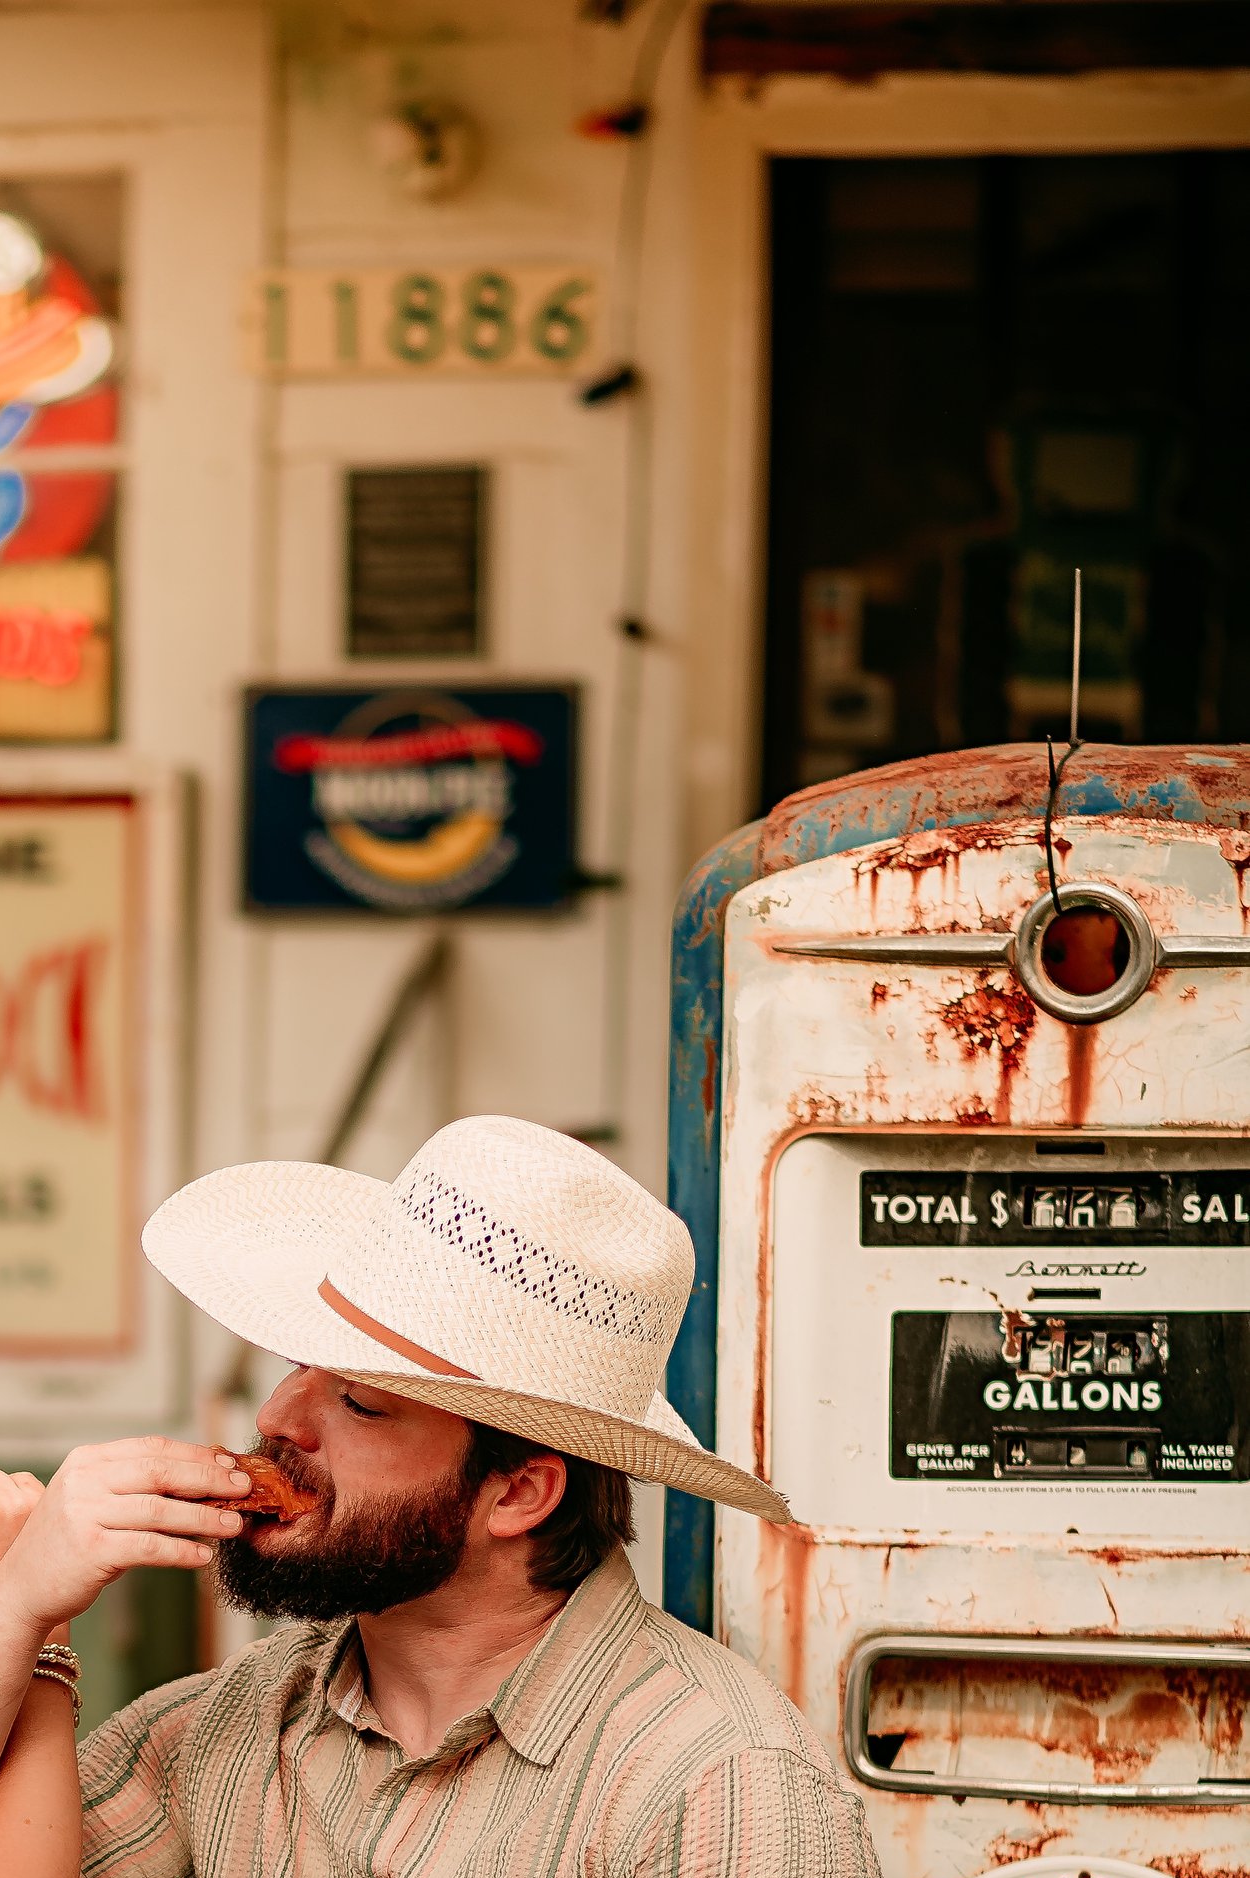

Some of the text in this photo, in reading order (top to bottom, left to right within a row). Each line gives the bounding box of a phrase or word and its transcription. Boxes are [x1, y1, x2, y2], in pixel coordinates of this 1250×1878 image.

[262, 271, 596, 365] 11886
[871, 1194, 978, 1224] TOTAL
[990, 1189, 1009, 1228] $
[1006, 1260, 1147, 1277] Bennett
[983, 1380, 1164, 1412] GALLONS
[906, 1443, 990, 1458] CENTS PER
[1161, 1444, 1235, 1457] ALL TAXES
[917, 1458, 976, 1471] GALLON
[1161, 1458, 1233, 1471] INCLUDED
